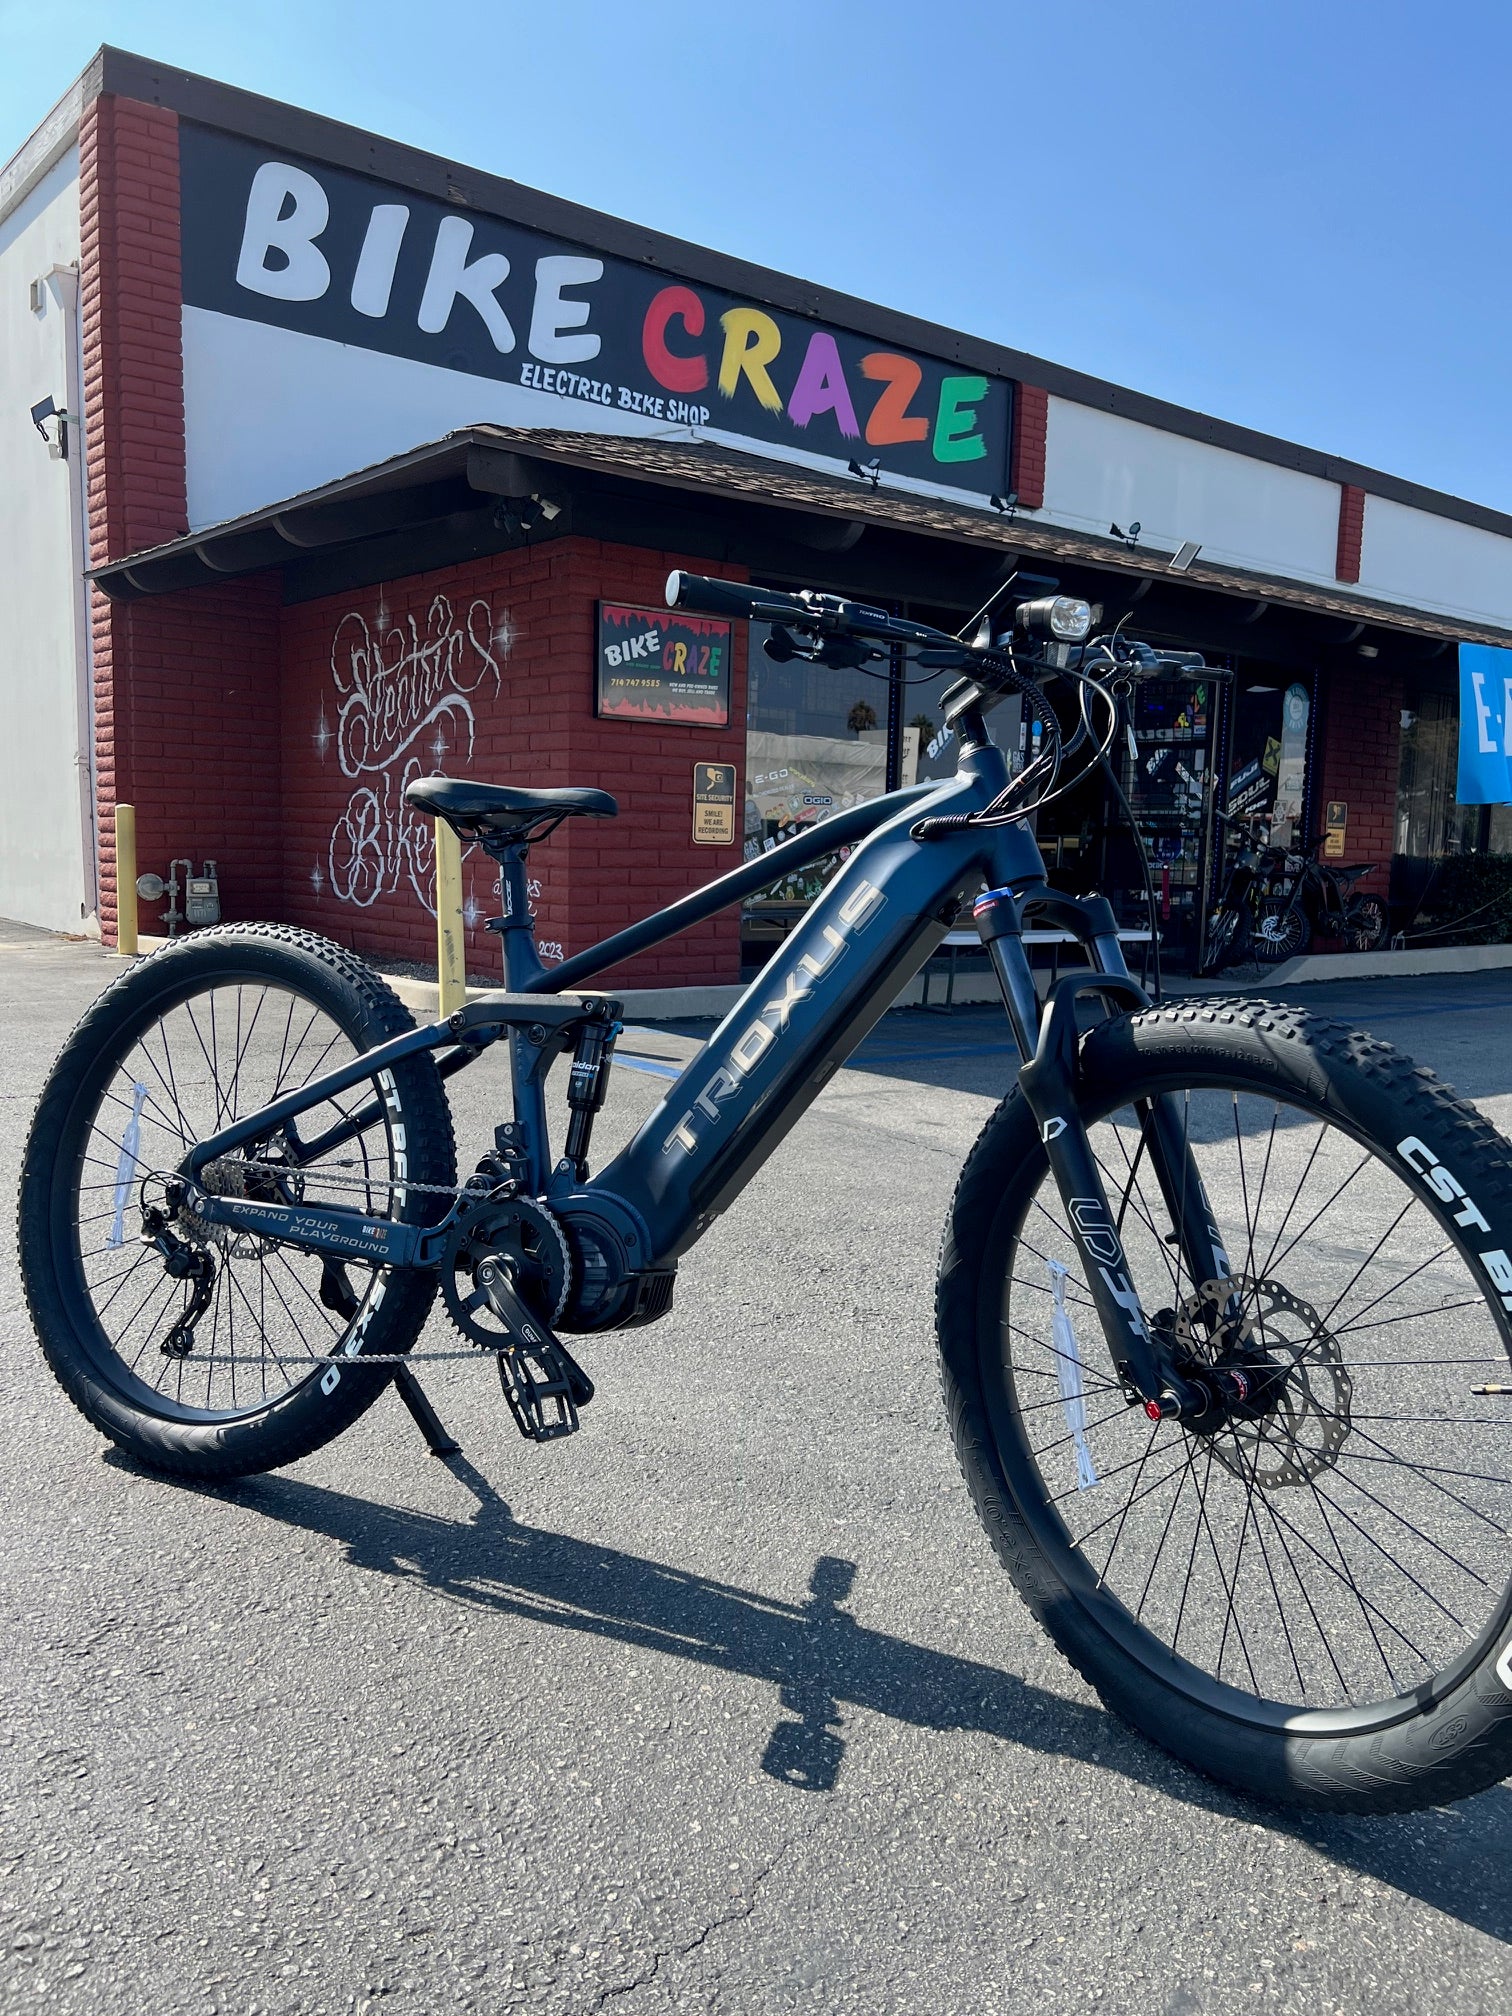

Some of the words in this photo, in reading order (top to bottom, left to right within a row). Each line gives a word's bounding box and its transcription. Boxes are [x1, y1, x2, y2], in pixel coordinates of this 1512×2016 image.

[235, 161, 604, 364] BIKE
[642, 285, 988, 463] CRAZE
[520, 363, 612, 405] ELECTRIC
[617, 386, 665, 418] BIKE
[666, 399, 711, 426] SHOP
[604, 629, 660, 667] BIKE
[662, 641, 722, 677] CRAZE
[611, 678, 625, 687] 714
[927, 722, 954, 759] BIK
[755, 768, 789, 784] E-GO
[1229, 761, 1259, 791] FUJI
[696, 793, 708, 801] SITE
[709, 794, 733, 802] SECURITY
[804, 796, 832, 804] OGIO
[698, 827, 729, 835] RECORDING
[704, 818, 712, 826] WE
[539, 940, 564, 962] 2023
[662, 879, 889, 1157] TROXUS
[377, 1067, 402, 1112] ST
[1396, 1135, 1492, 1233] CST
[232, 1205, 289, 1222] EXPAND
[295, 1216, 338, 1231] YOUR
[289, 1225, 389, 1255] PLAYGROUND
